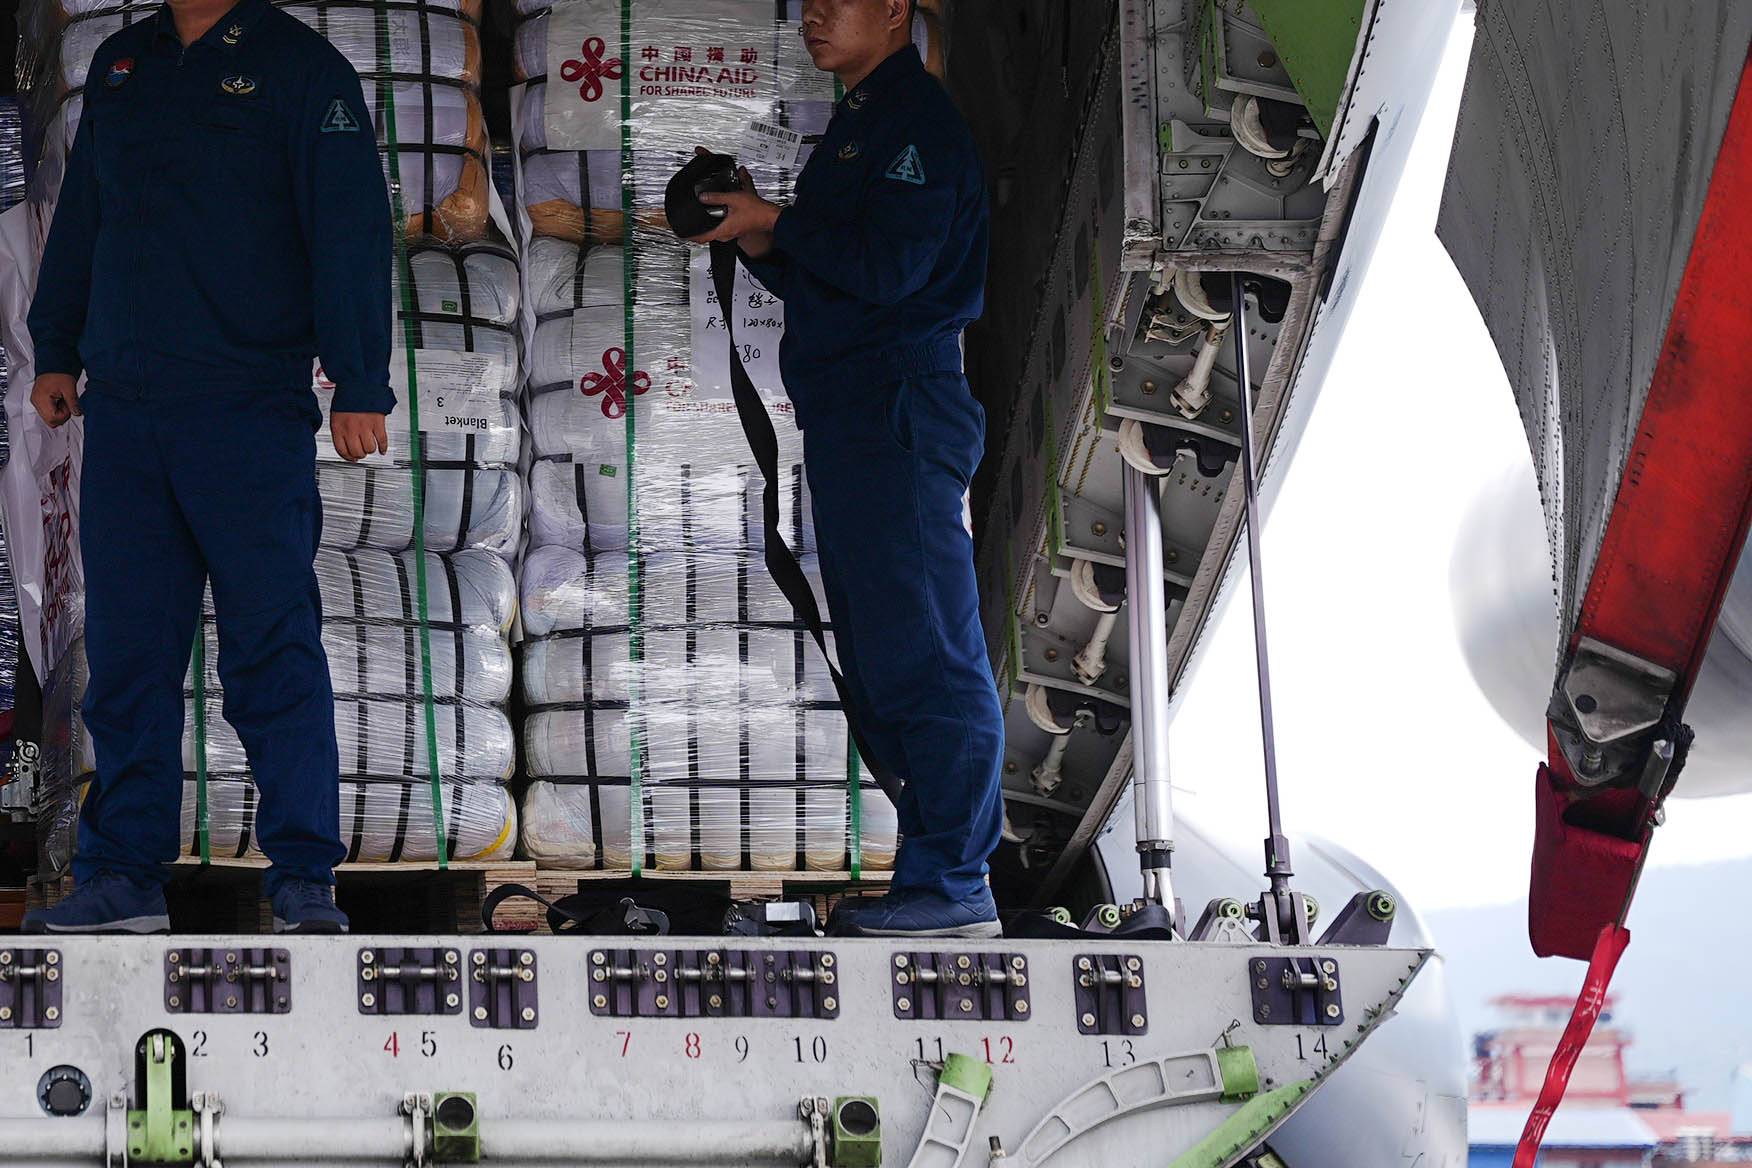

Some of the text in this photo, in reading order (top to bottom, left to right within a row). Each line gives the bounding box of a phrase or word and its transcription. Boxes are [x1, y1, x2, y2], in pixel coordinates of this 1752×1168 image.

[641, 45, 758, 64] 中国援助
[639, 66, 758, 84] CHINA AID
[640, 85, 758, 98] FOR SHARED FUTURE
[436, 396, 445, 408] 3
[444, 415, 487, 429] Blanket
[26, 1032, 33, 1059] 1
[192, 1030, 208, 1057] 2
[253, 1031, 270, 1057] 3
[384, 1032, 400, 1058] 4
[421, 1031, 437, 1057] 5
[497, 1043, 514, 1071] 6
[616, 1031, 632, 1058] 7
[685, 1032, 702, 1059] 8
[734, 1035, 750, 1063] 9
[793, 1035, 827, 1063] 10
[916, 1036, 945, 1064] 11
[980, 1036, 1016, 1064] 12
[1101, 1038, 1136, 1068] 13
[1296, 1034, 1329, 1061] 14
